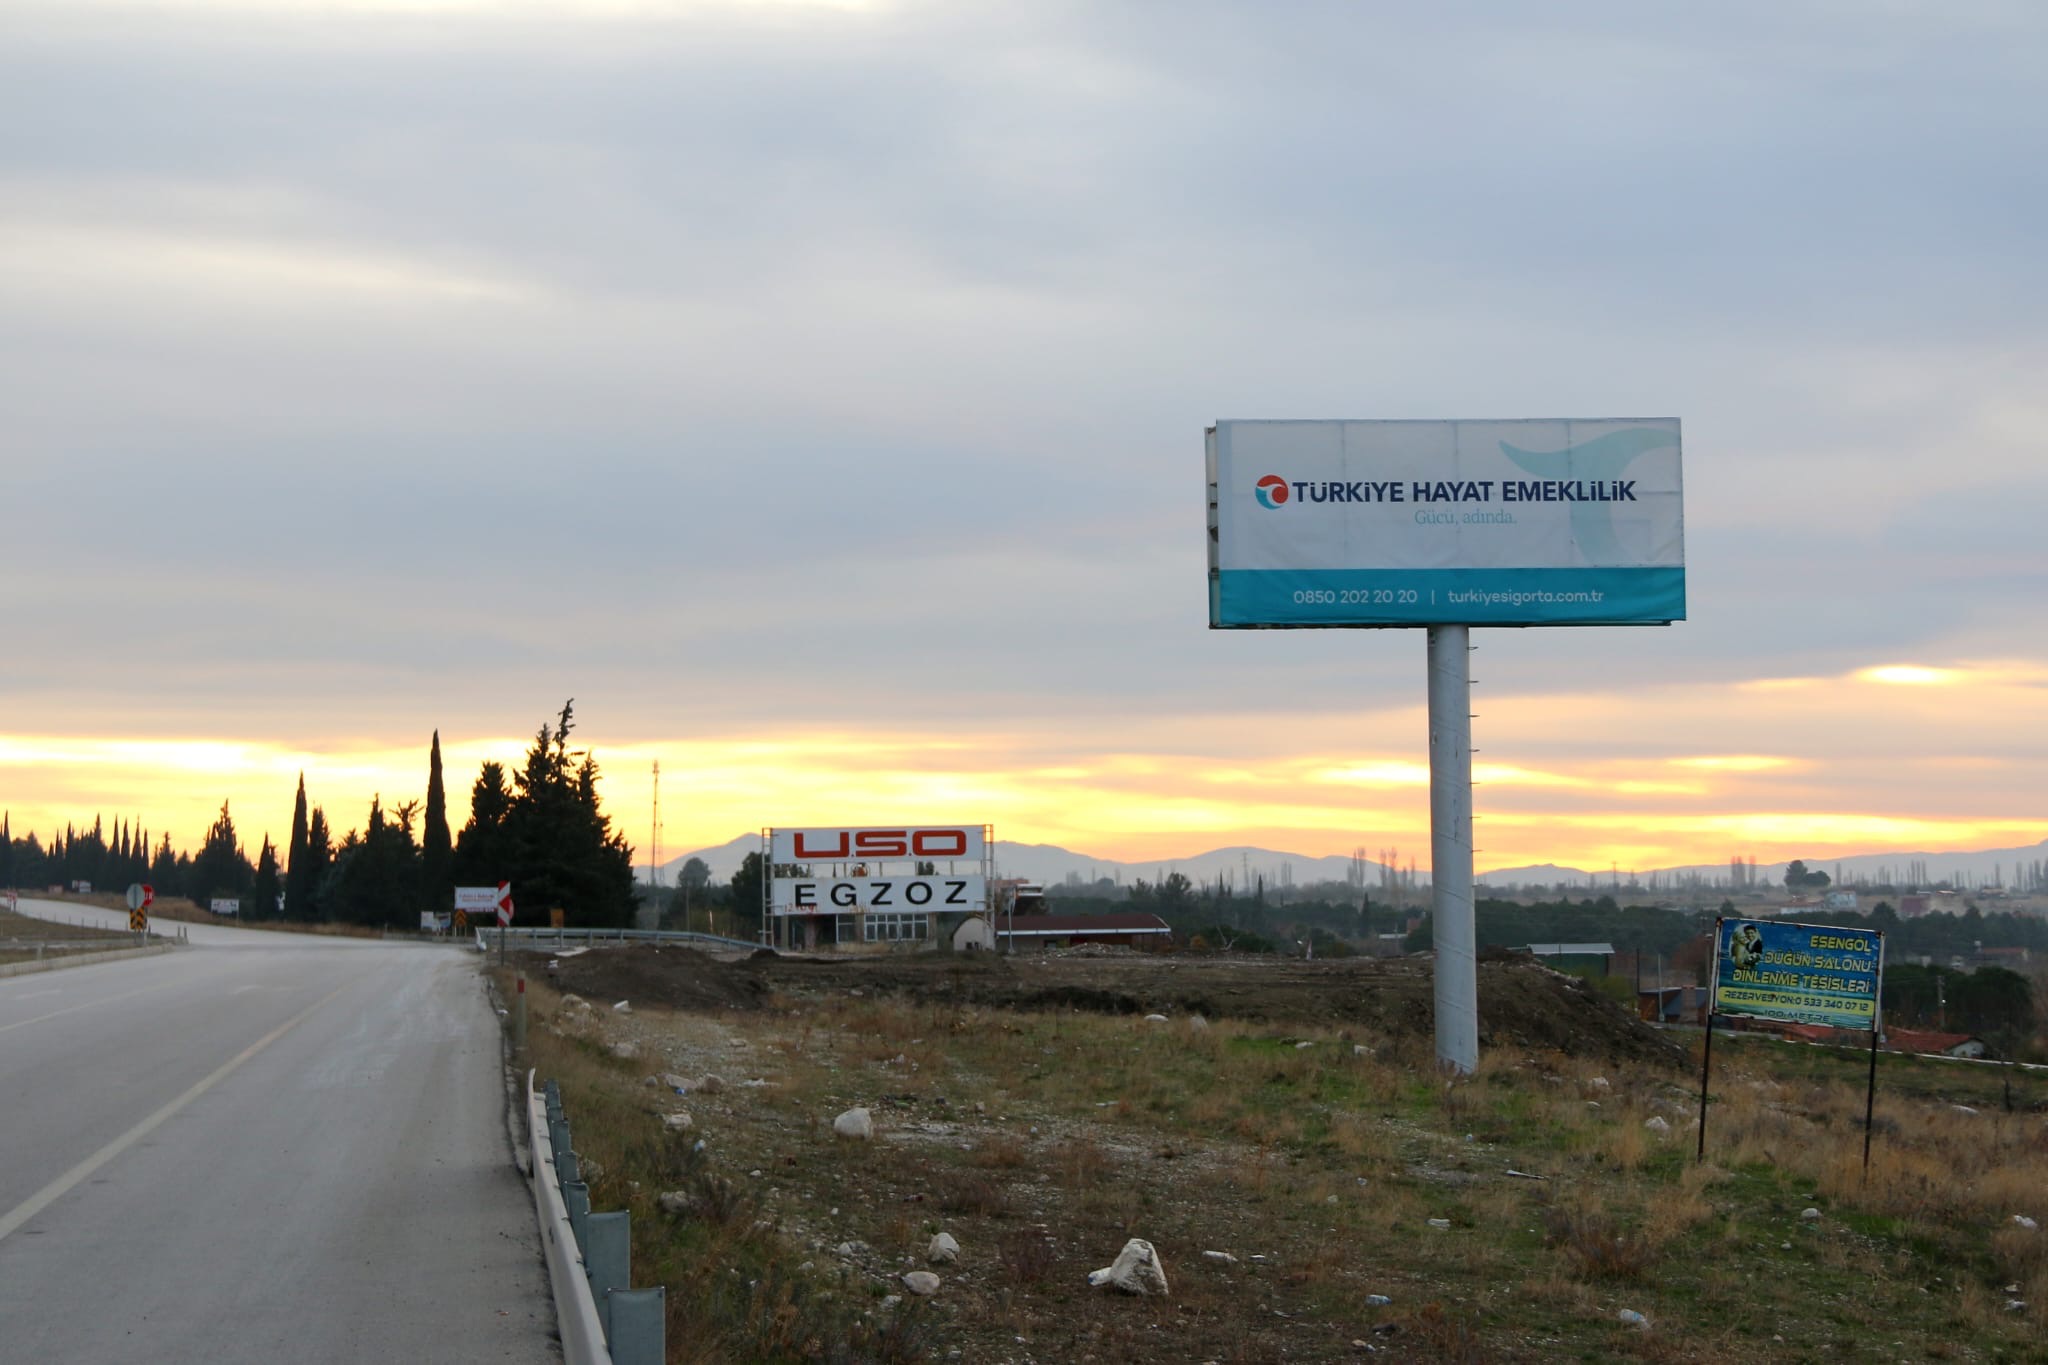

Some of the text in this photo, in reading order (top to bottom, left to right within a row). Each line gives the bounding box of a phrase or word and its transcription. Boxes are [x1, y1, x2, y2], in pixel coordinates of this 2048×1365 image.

[1413, 481, 1494, 502] HAYAT
[1414, 508, 1517, 525] Gücü, adında.
[1293, 589, 1604, 606] 0850 202 20 20 turkiyesigorta.com.tr
[794, 881, 967, 907] EGZOZ
[1814, 956, 1872, 972] SALONU
[1732, 968, 1870, 993] DİNLENME TESİSLERİ
[1804, 997, 1822, 1007] 533
[1824, 998, 1842, 1009] 340
[1845, 1000, 1857, 1010] 07
[1859, 1002, 1869, 1011] 12
